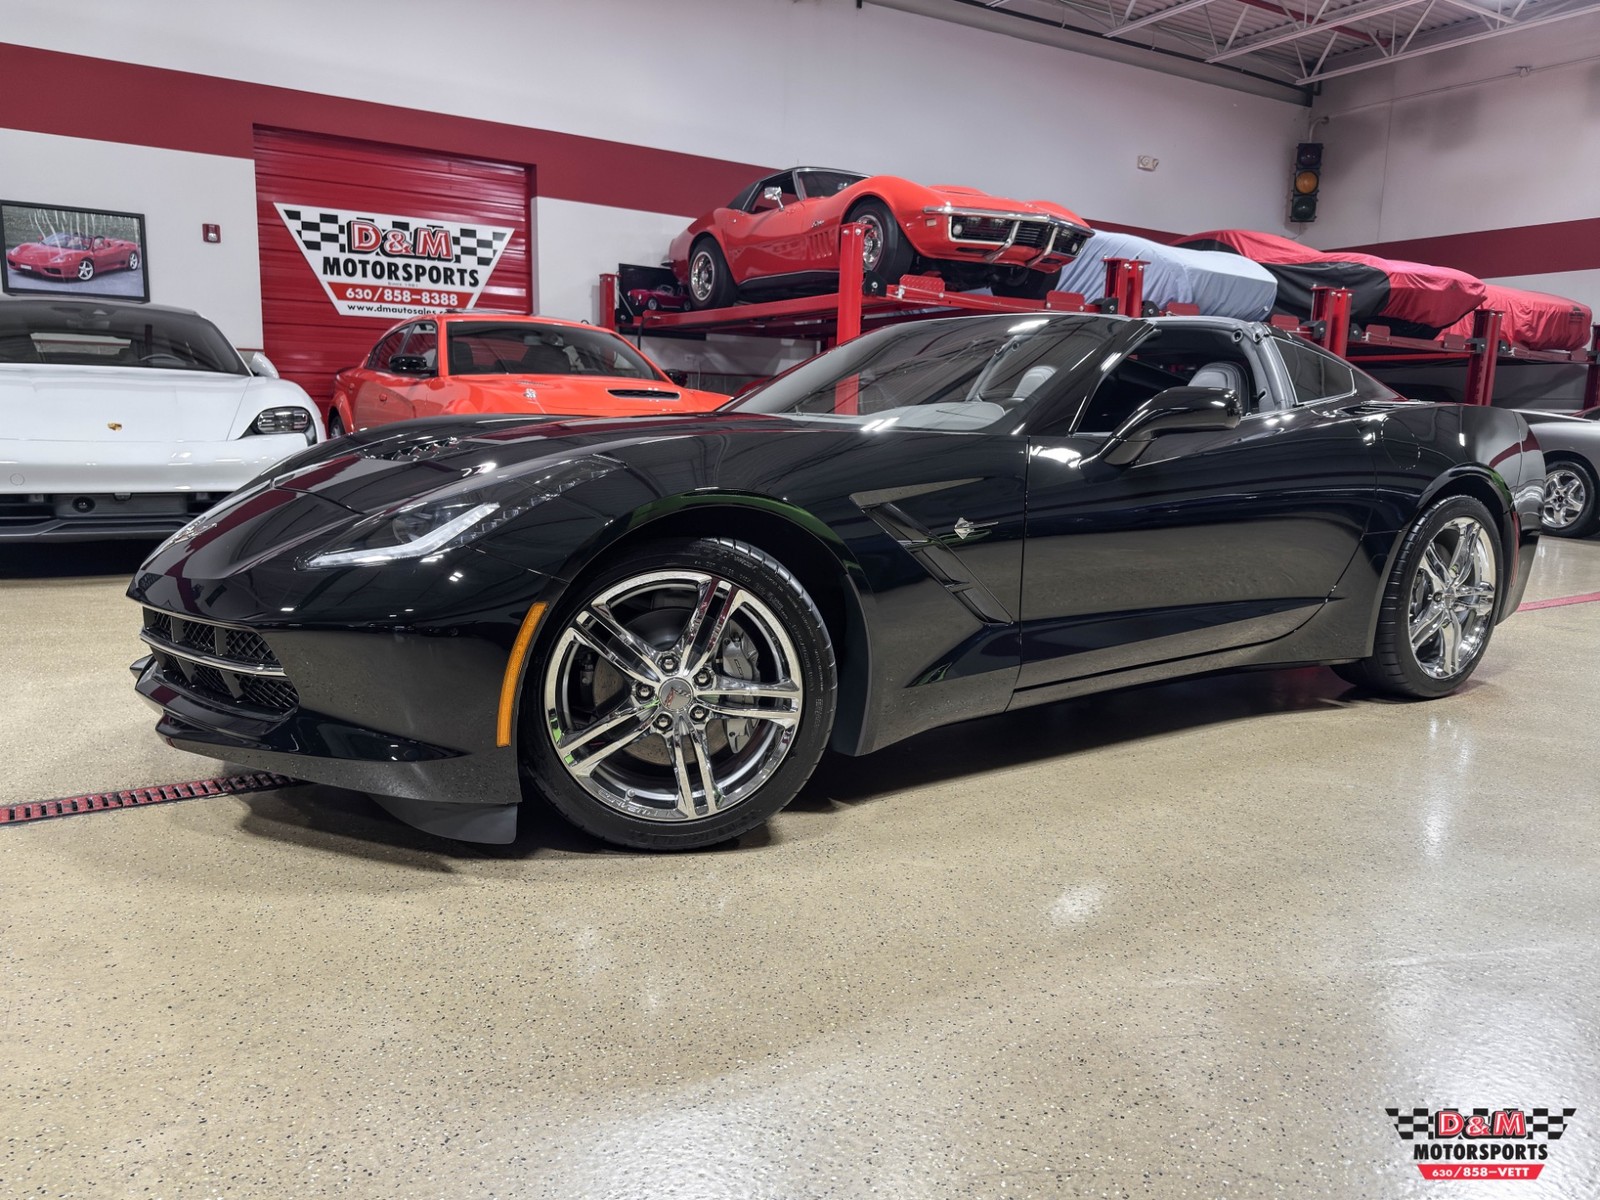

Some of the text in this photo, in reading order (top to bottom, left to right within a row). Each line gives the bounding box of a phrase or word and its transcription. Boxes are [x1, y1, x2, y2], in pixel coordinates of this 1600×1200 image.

[347, 220, 454, 261] D&M
[322, 257, 480, 287] MOTORSPORTS
[345, 287, 459, 307] 630/858-8388
[347, 304, 448, 316] www.dmautosales
